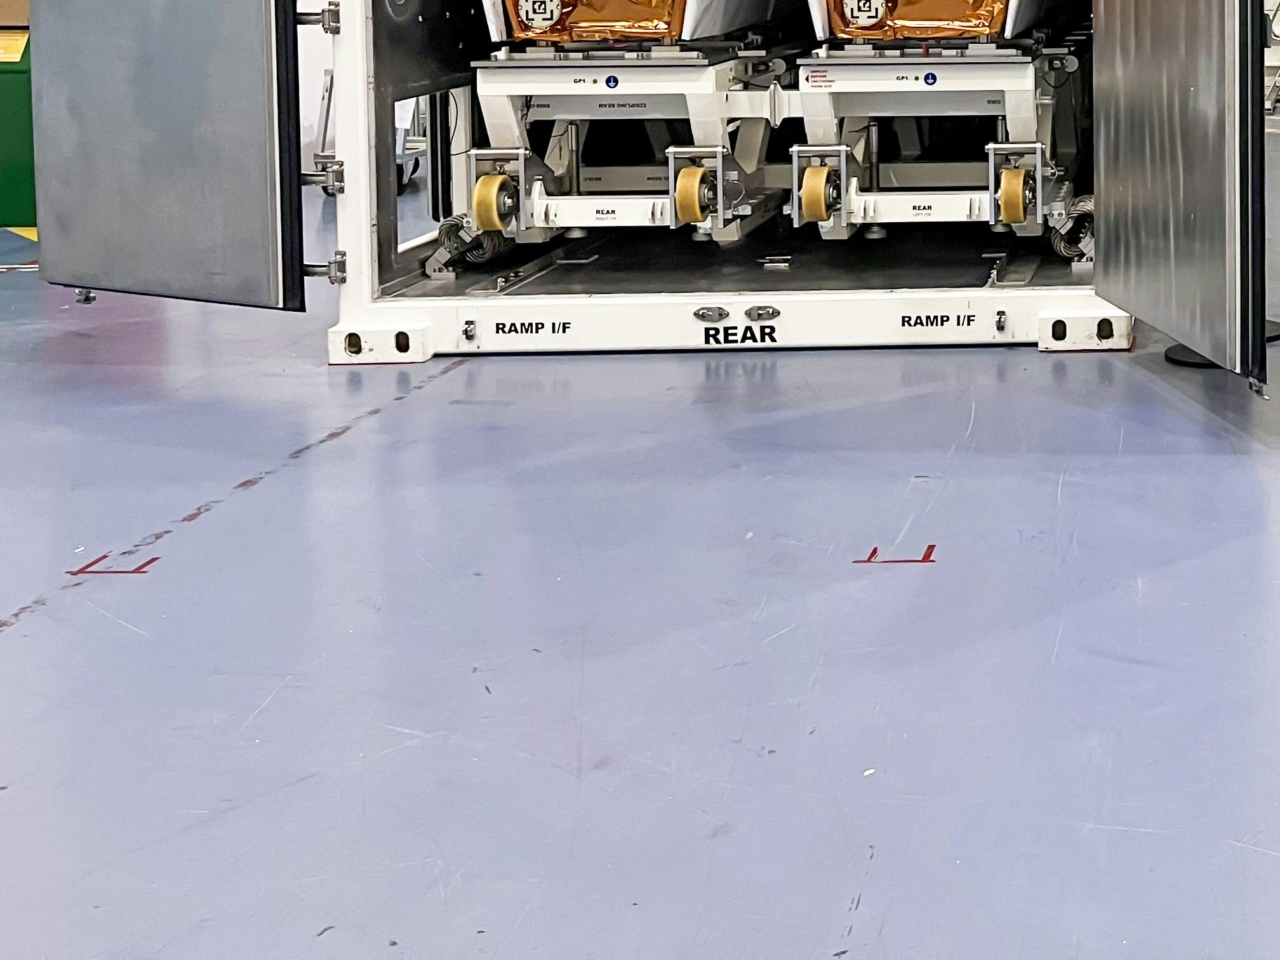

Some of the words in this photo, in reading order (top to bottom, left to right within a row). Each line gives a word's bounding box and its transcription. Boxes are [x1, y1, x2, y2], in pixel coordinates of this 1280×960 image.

[902, 315, 949, 327] RAMP
[957, 315, 975, 326] I/F
[496, 323, 544, 334] RAMP
[552, 322, 571, 333] I/F
[705, 326, 777, 344] REAR
